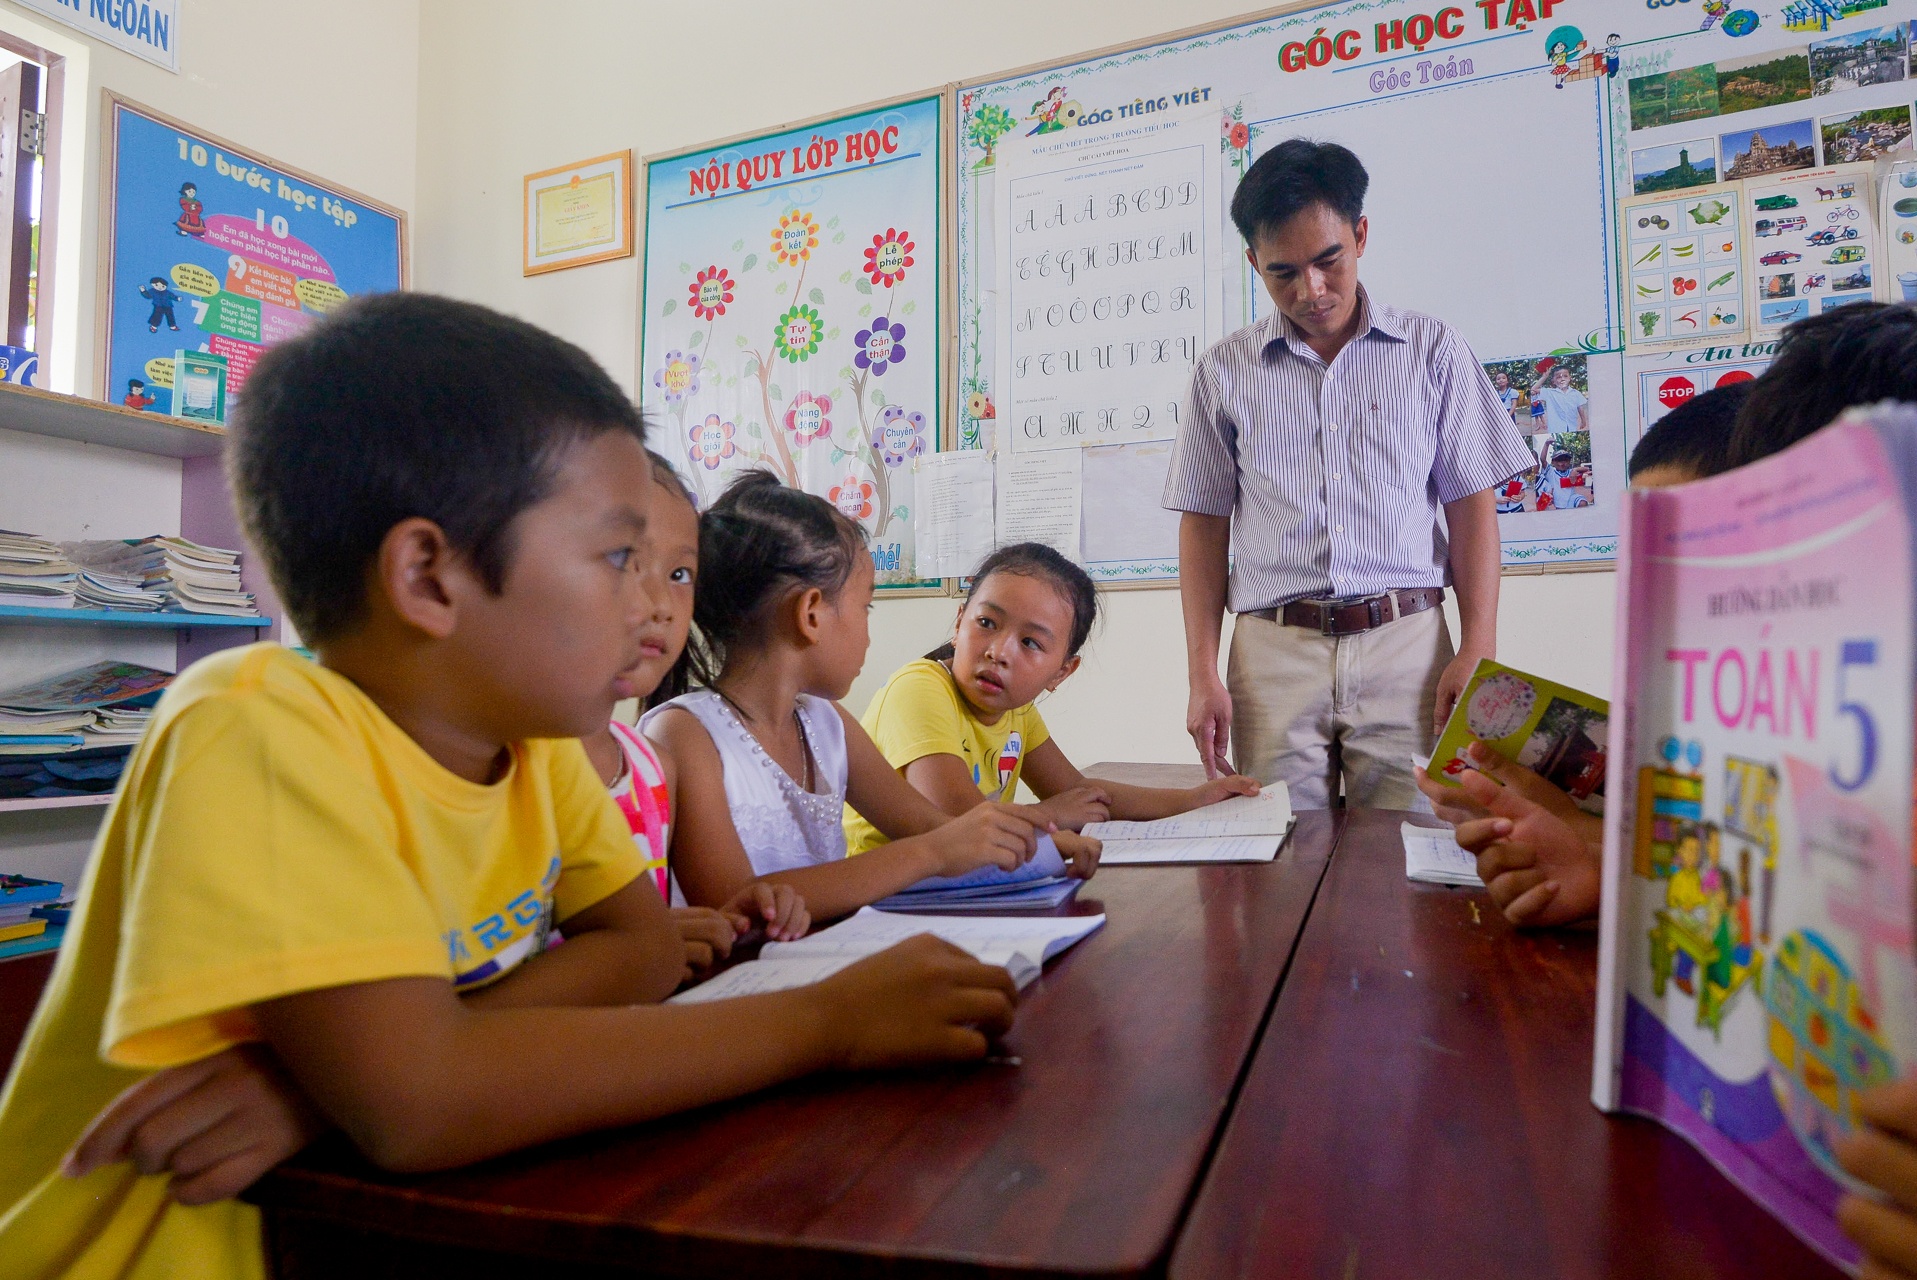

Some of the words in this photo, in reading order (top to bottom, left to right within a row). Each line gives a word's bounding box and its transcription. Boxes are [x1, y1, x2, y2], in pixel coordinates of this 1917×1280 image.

[1278, 27, 1362, 73] GÓC
[1374, 7, 1465, 53] HỌC
[1369, 66, 1411, 93] Góc
[1416, 55, 1475, 85] Toán
[1077, 108, 1114, 127] GÓC
[1083, 134, 1109, 146] TRONG
[689, 158, 730, 198] NỘI
[736, 149, 786, 191] QUY
[792, 135, 839, 174] LỚP
[845, 125, 899, 164] HỌC
[177, 137, 208, 167] 10
[215, 152, 271, 193] bước
[278, 178, 316, 212] học
[323, 196, 357, 228] tập
[256, 207, 289, 239] 10
[223, 224, 237, 235] Em
[251, 234, 266, 246] học
[267, 241, 287, 253] xong
[784, 229, 806, 240] Đoàn
[231, 239, 244, 248] em
[265, 249, 279, 260] học
[788, 240, 802, 250] kết
[885, 244, 897, 255] Lễ
[228, 254, 247, 280] 9
[879, 256, 903, 269] phép
[250, 278, 263, 286] em
[191, 299, 210, 325] 7
[789, 325, 807, 335] Tự
[789, 336, 806, 345] tin
[869, 348, 890, 359] thận
[1659, 387, 1694, 399] STOP
[797, 409, 820, 419] Năng
[798, 420, 819, 431] động
[703, 432, 721, 441] Học
[885, 426, 914, 438] Chuyên
[1665, 622, 1819, 741] TOÁN
[1829, 639, 1880, 792] 5
